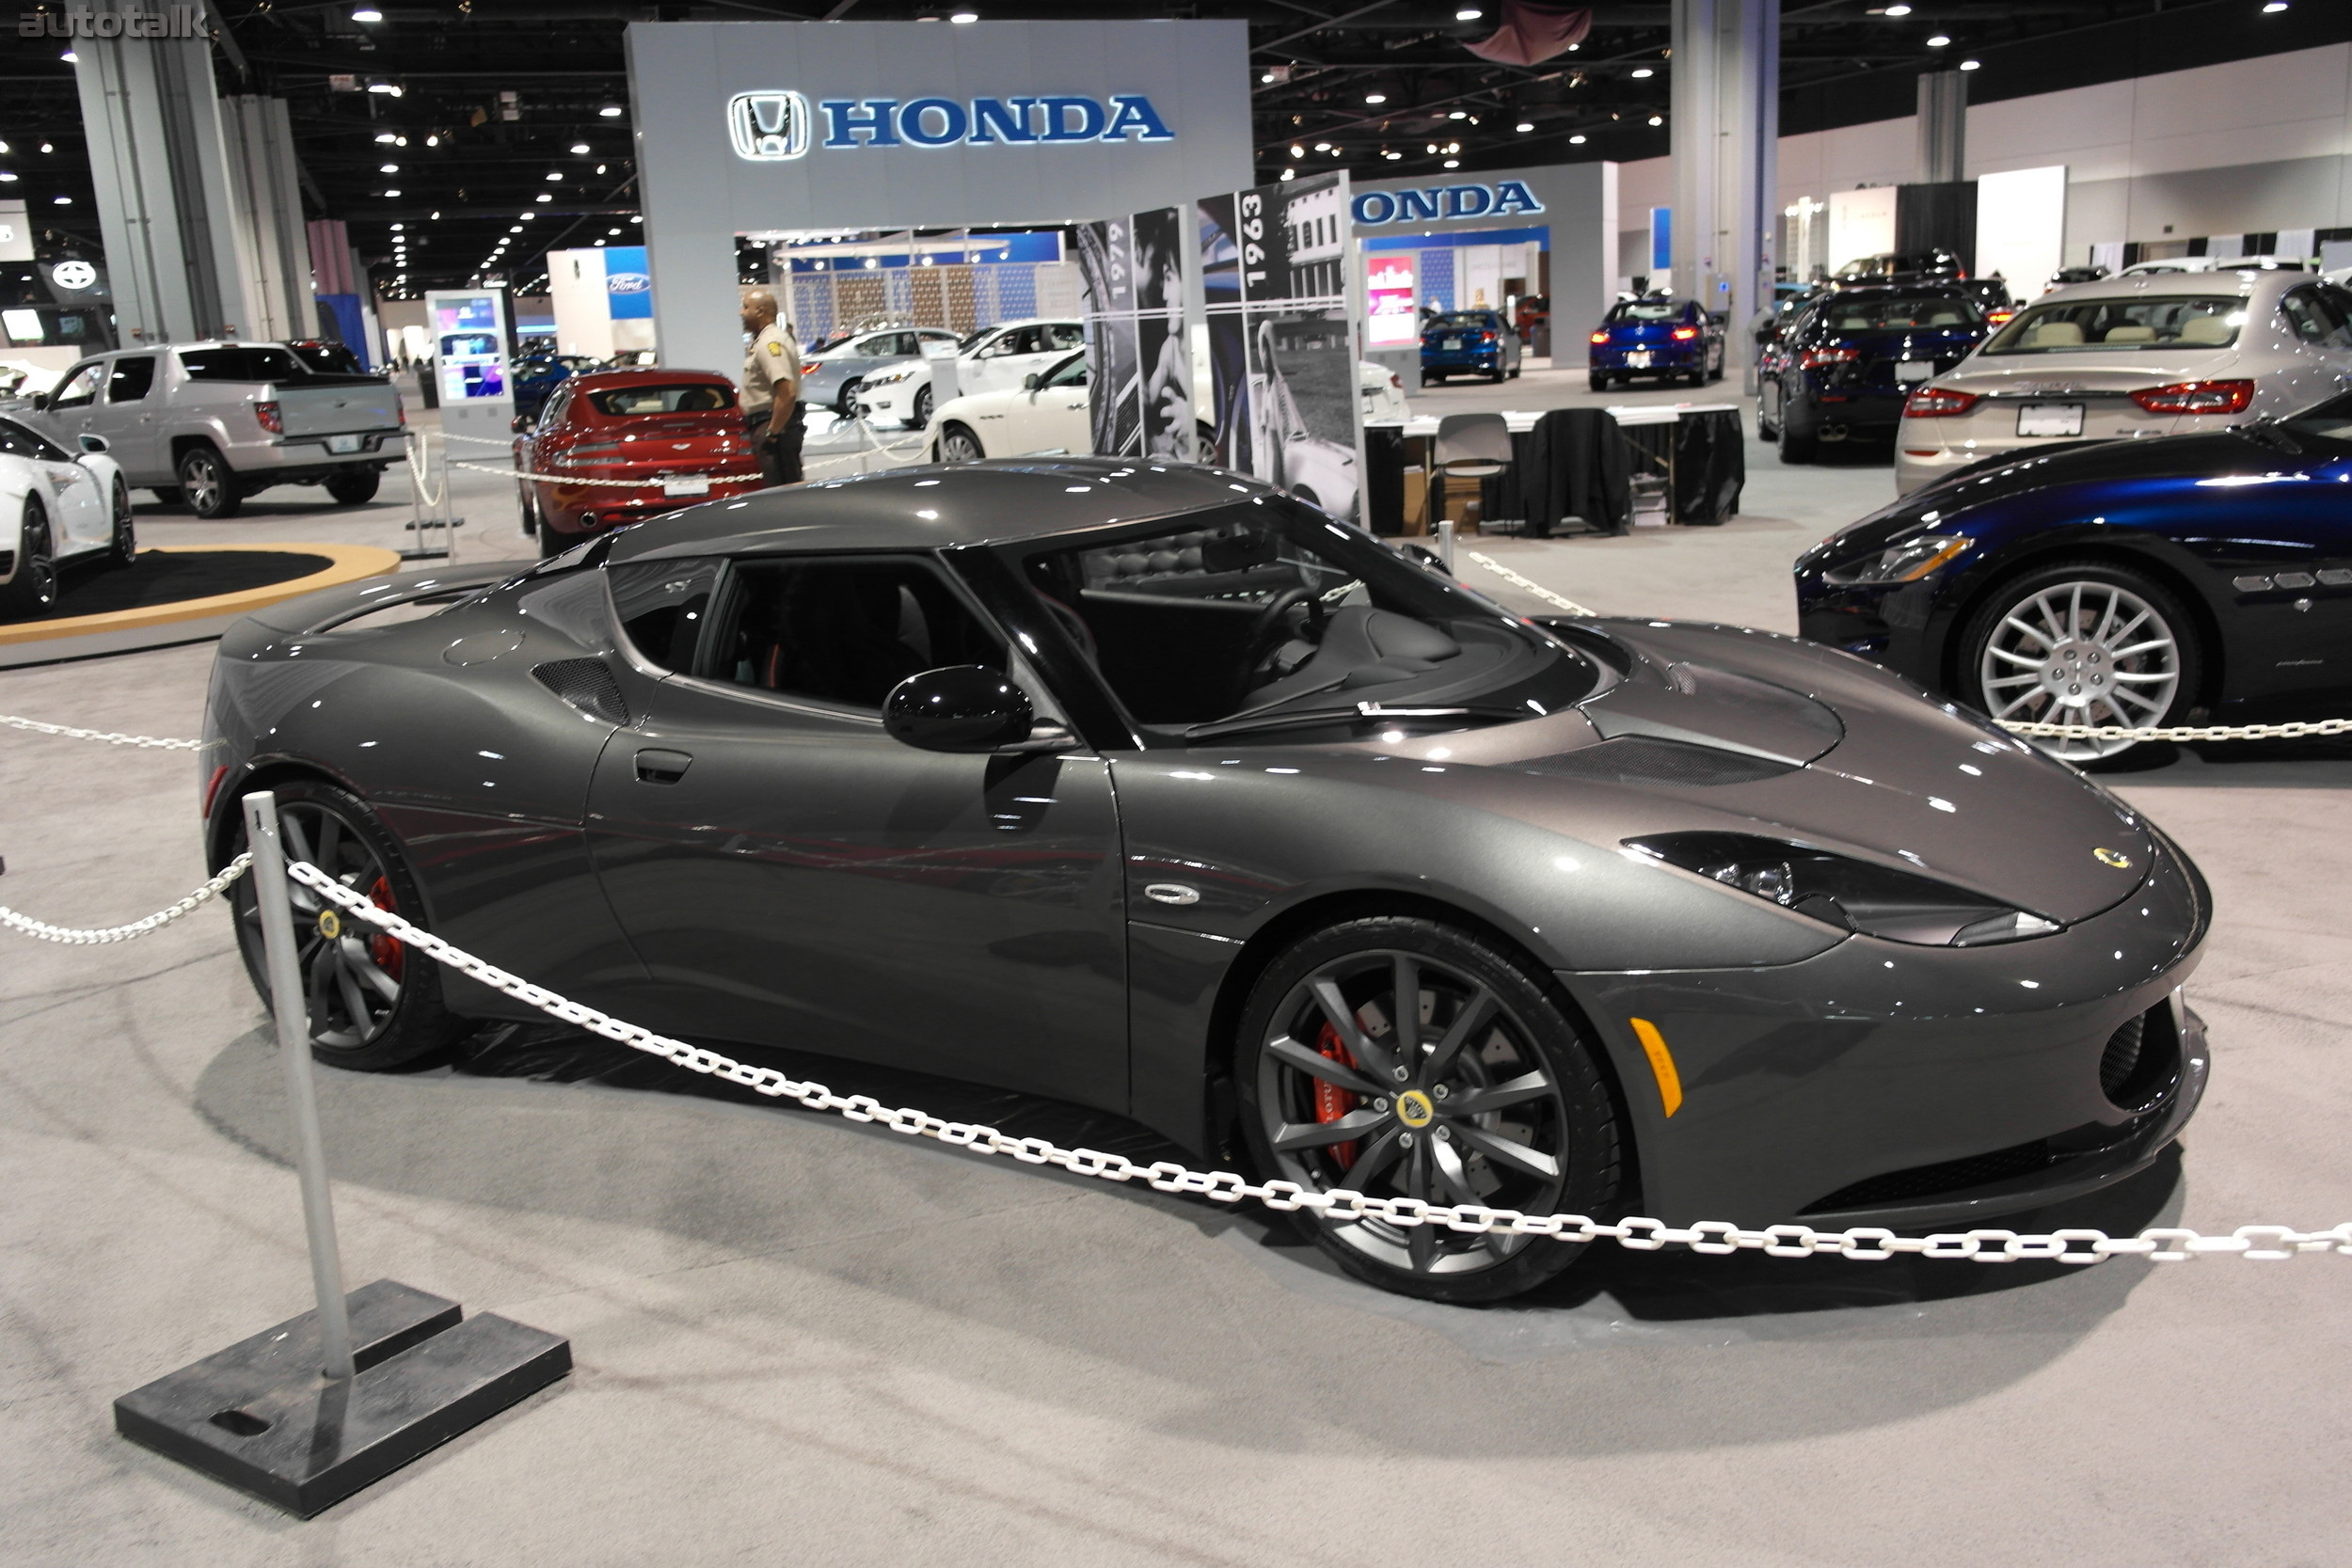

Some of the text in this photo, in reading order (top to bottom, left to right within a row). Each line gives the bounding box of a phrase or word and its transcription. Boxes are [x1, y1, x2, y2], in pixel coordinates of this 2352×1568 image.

[819, 95, 1175, 149] HONDA
[1350, 180, 1546, 227] ONDA
[1108, 222, 1126, 300] 1979
[1242, 193, 1266, 288] 1963
[609, 276, 644, 292] Ford
